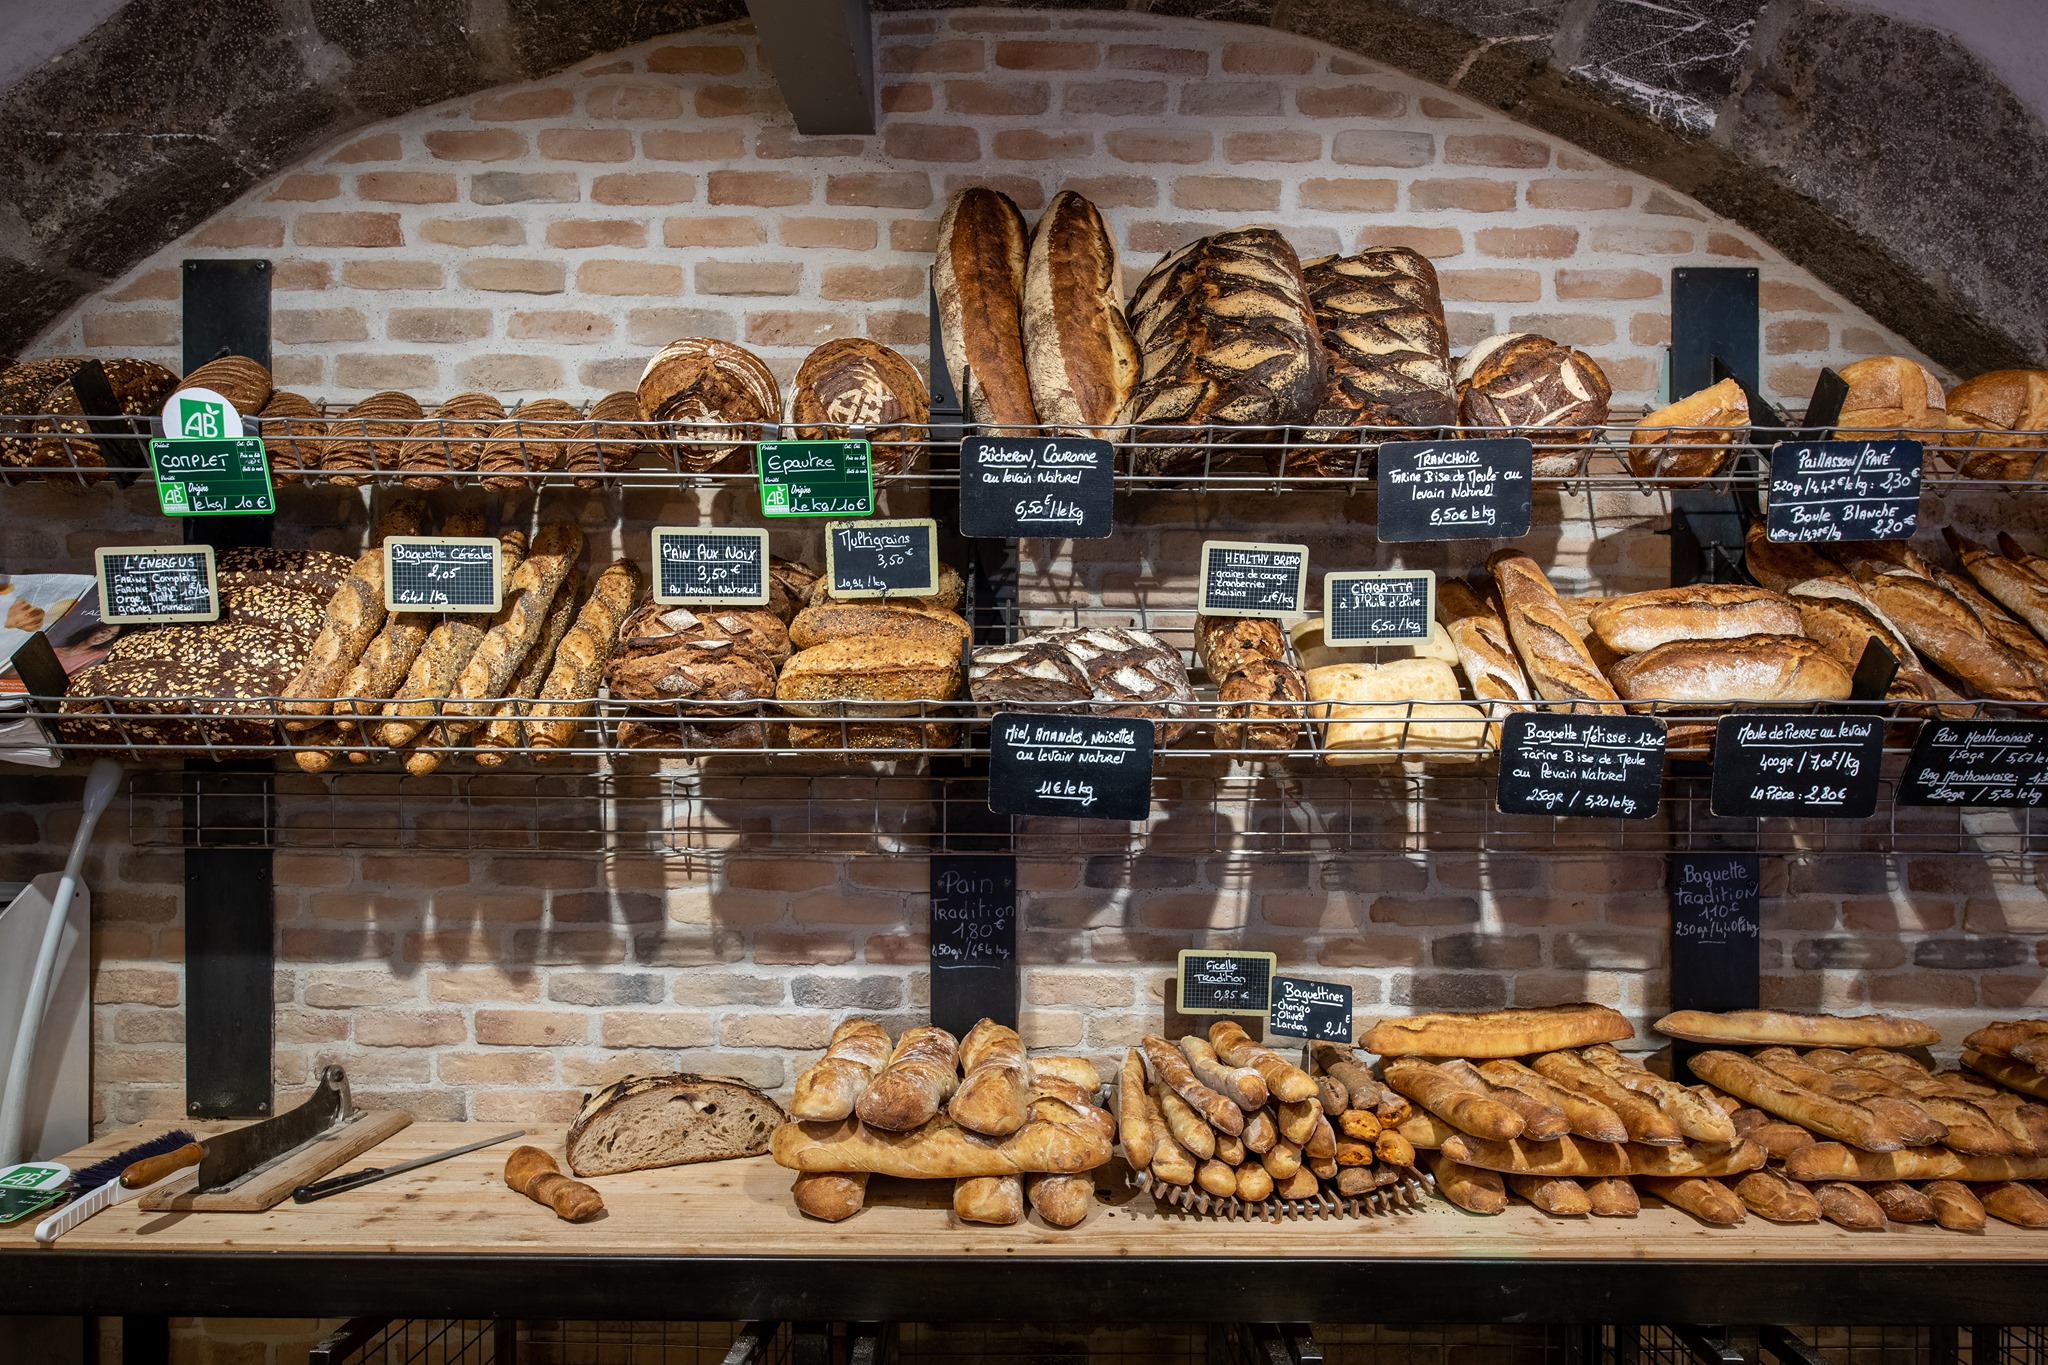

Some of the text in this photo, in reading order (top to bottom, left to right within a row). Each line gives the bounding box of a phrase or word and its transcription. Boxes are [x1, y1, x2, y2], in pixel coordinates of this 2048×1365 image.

[184, 411, 219, 438] AB
[160, 453, 229, 468] COMPLET
[982, 473, 999, 483] au
[1002, 468, 1032, 483] levain
[1503, 470, 1523, 481] au
[164, 488, 183, 504] AB
[766, 490, 785, 505] AB
[1412, 485, 1445, 501] levain
[1790, 506, 1831, 524] Boule
[392, 544, 493, 565] Baguette Céréales
[1225, 551, 1269, 565] HEALTHY
[427, 564, 460, 581] 2,05
[1523, 722, 1577, 744] Baguette
[1820, 728, 1836, 738] au
[1933, 727, 1958, 743] Pain
[1016, 750, 1034, 761] au
[1598, 753, 1612, 765] de
[1512, 769, 1530, 778] au
[942, 870, 993, 894] Pain
[1684, 861, 1748, 888] Baguette
[1206, 959, 1238, 970] Ficelle
[1283, 982, 1344, 1004] Baguettines
